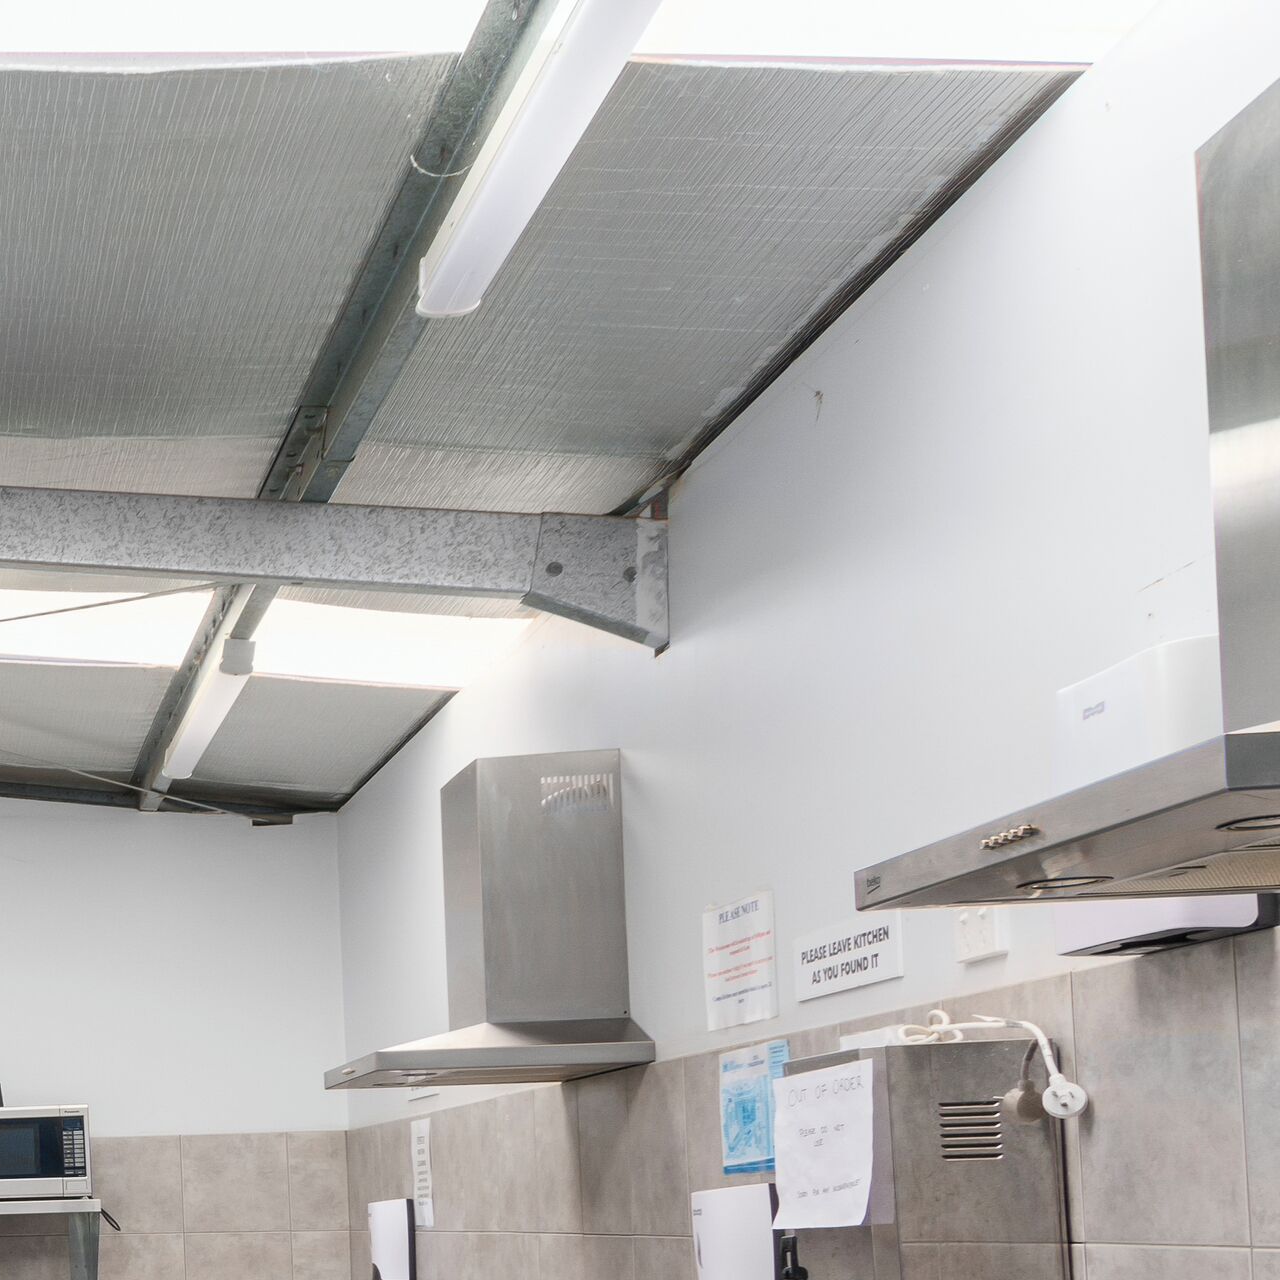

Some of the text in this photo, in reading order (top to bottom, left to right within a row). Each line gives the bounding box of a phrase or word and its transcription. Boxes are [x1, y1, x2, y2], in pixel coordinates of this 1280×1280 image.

[718, 899, 760, 925] PLEASE NOTE
[801, 925, 890, 965] PLEASE LEAVE KITCHEN
[811, 953, 879, 985] AS YOU FOUND IT
[787, 1075, 864, 1107] OUT OF ORDER
